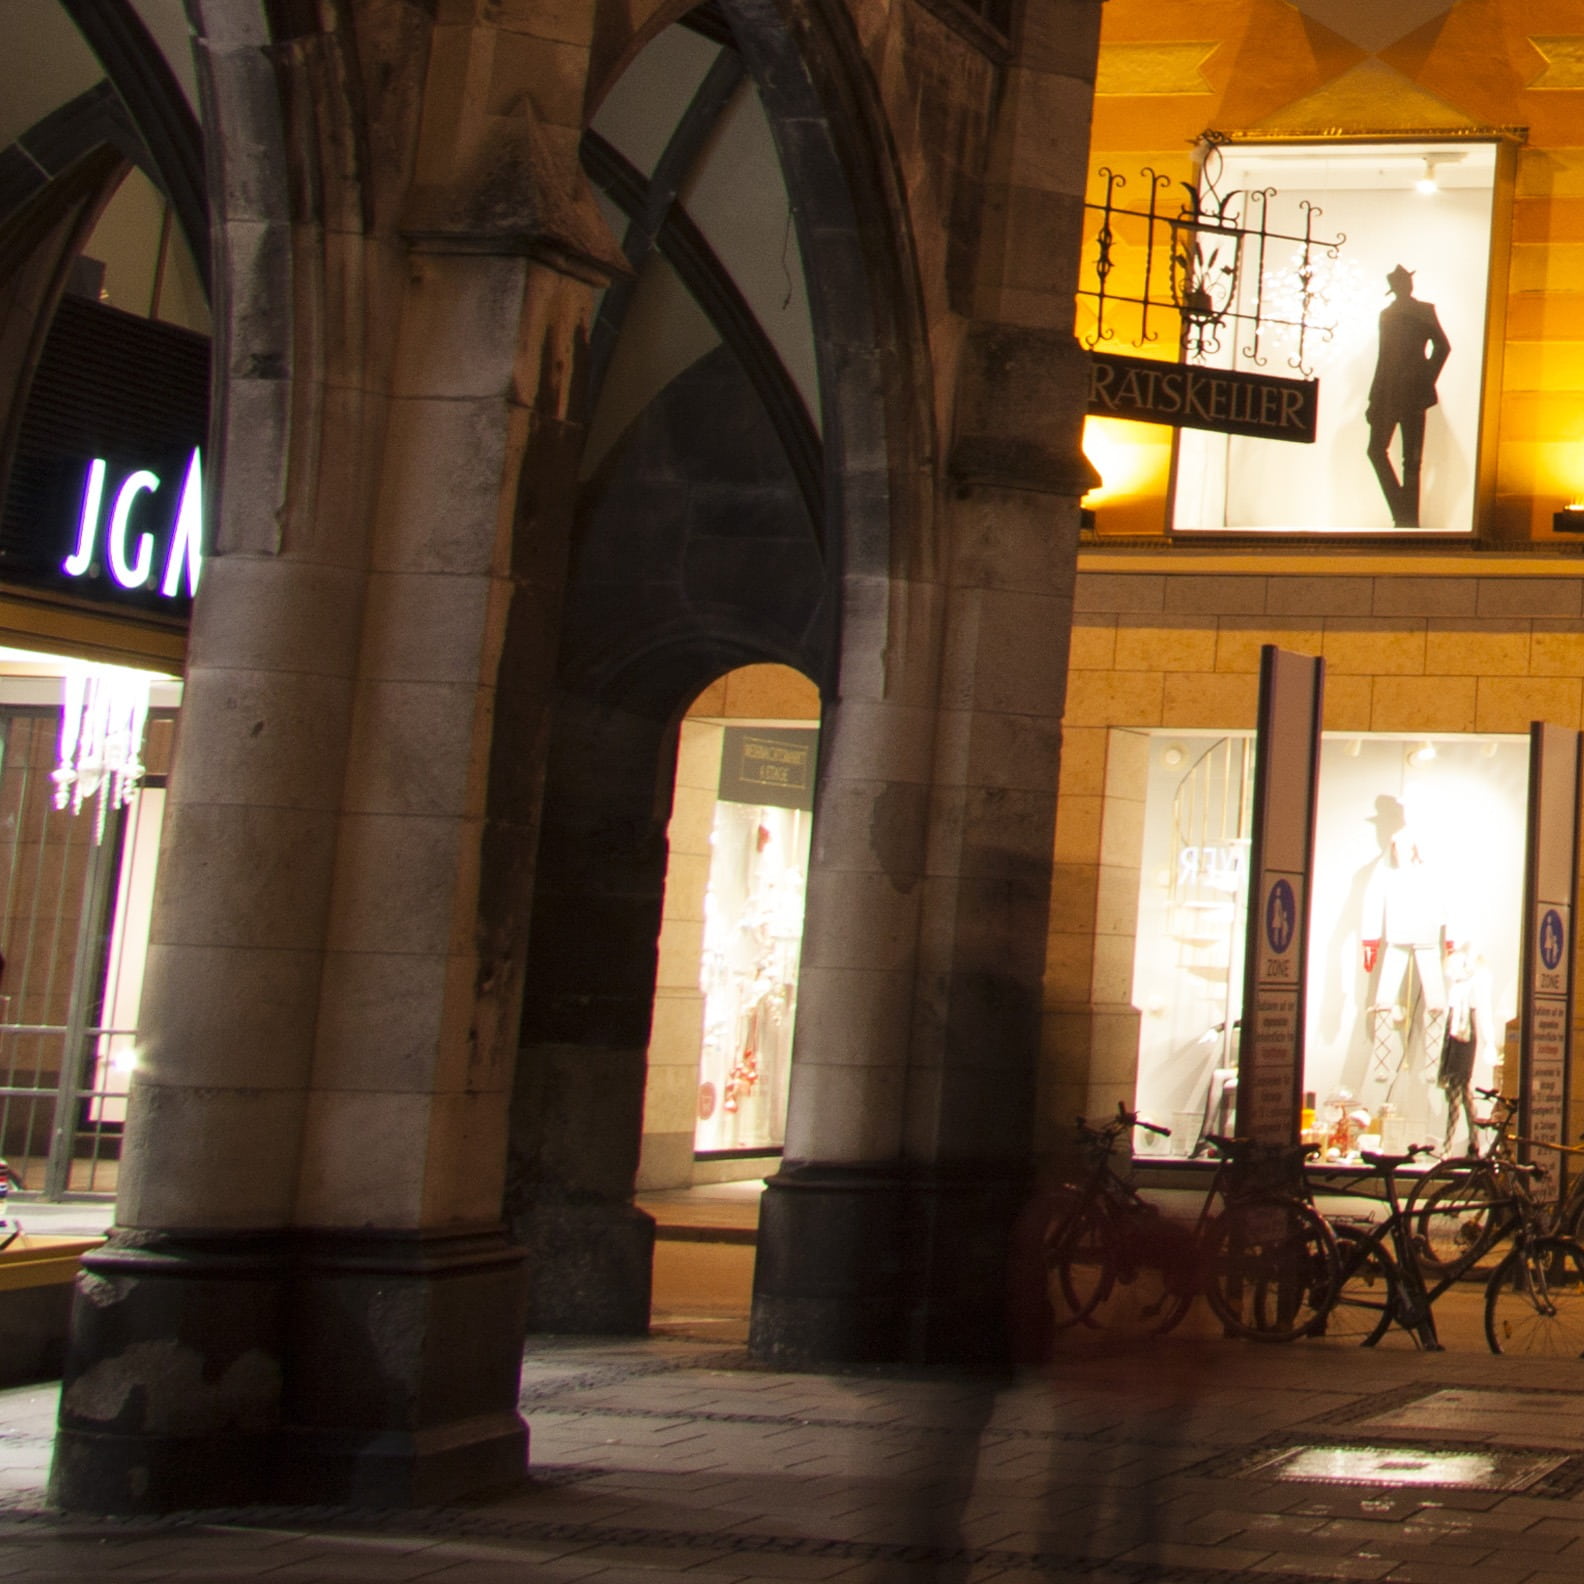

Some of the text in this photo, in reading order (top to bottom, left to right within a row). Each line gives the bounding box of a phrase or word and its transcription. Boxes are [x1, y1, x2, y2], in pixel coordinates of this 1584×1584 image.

[1088, 362, 1306, 428] RATSKELLER
[1266, 959, 1291, 978] ZONE
[1540, 973, 1560, 990] ZONE
